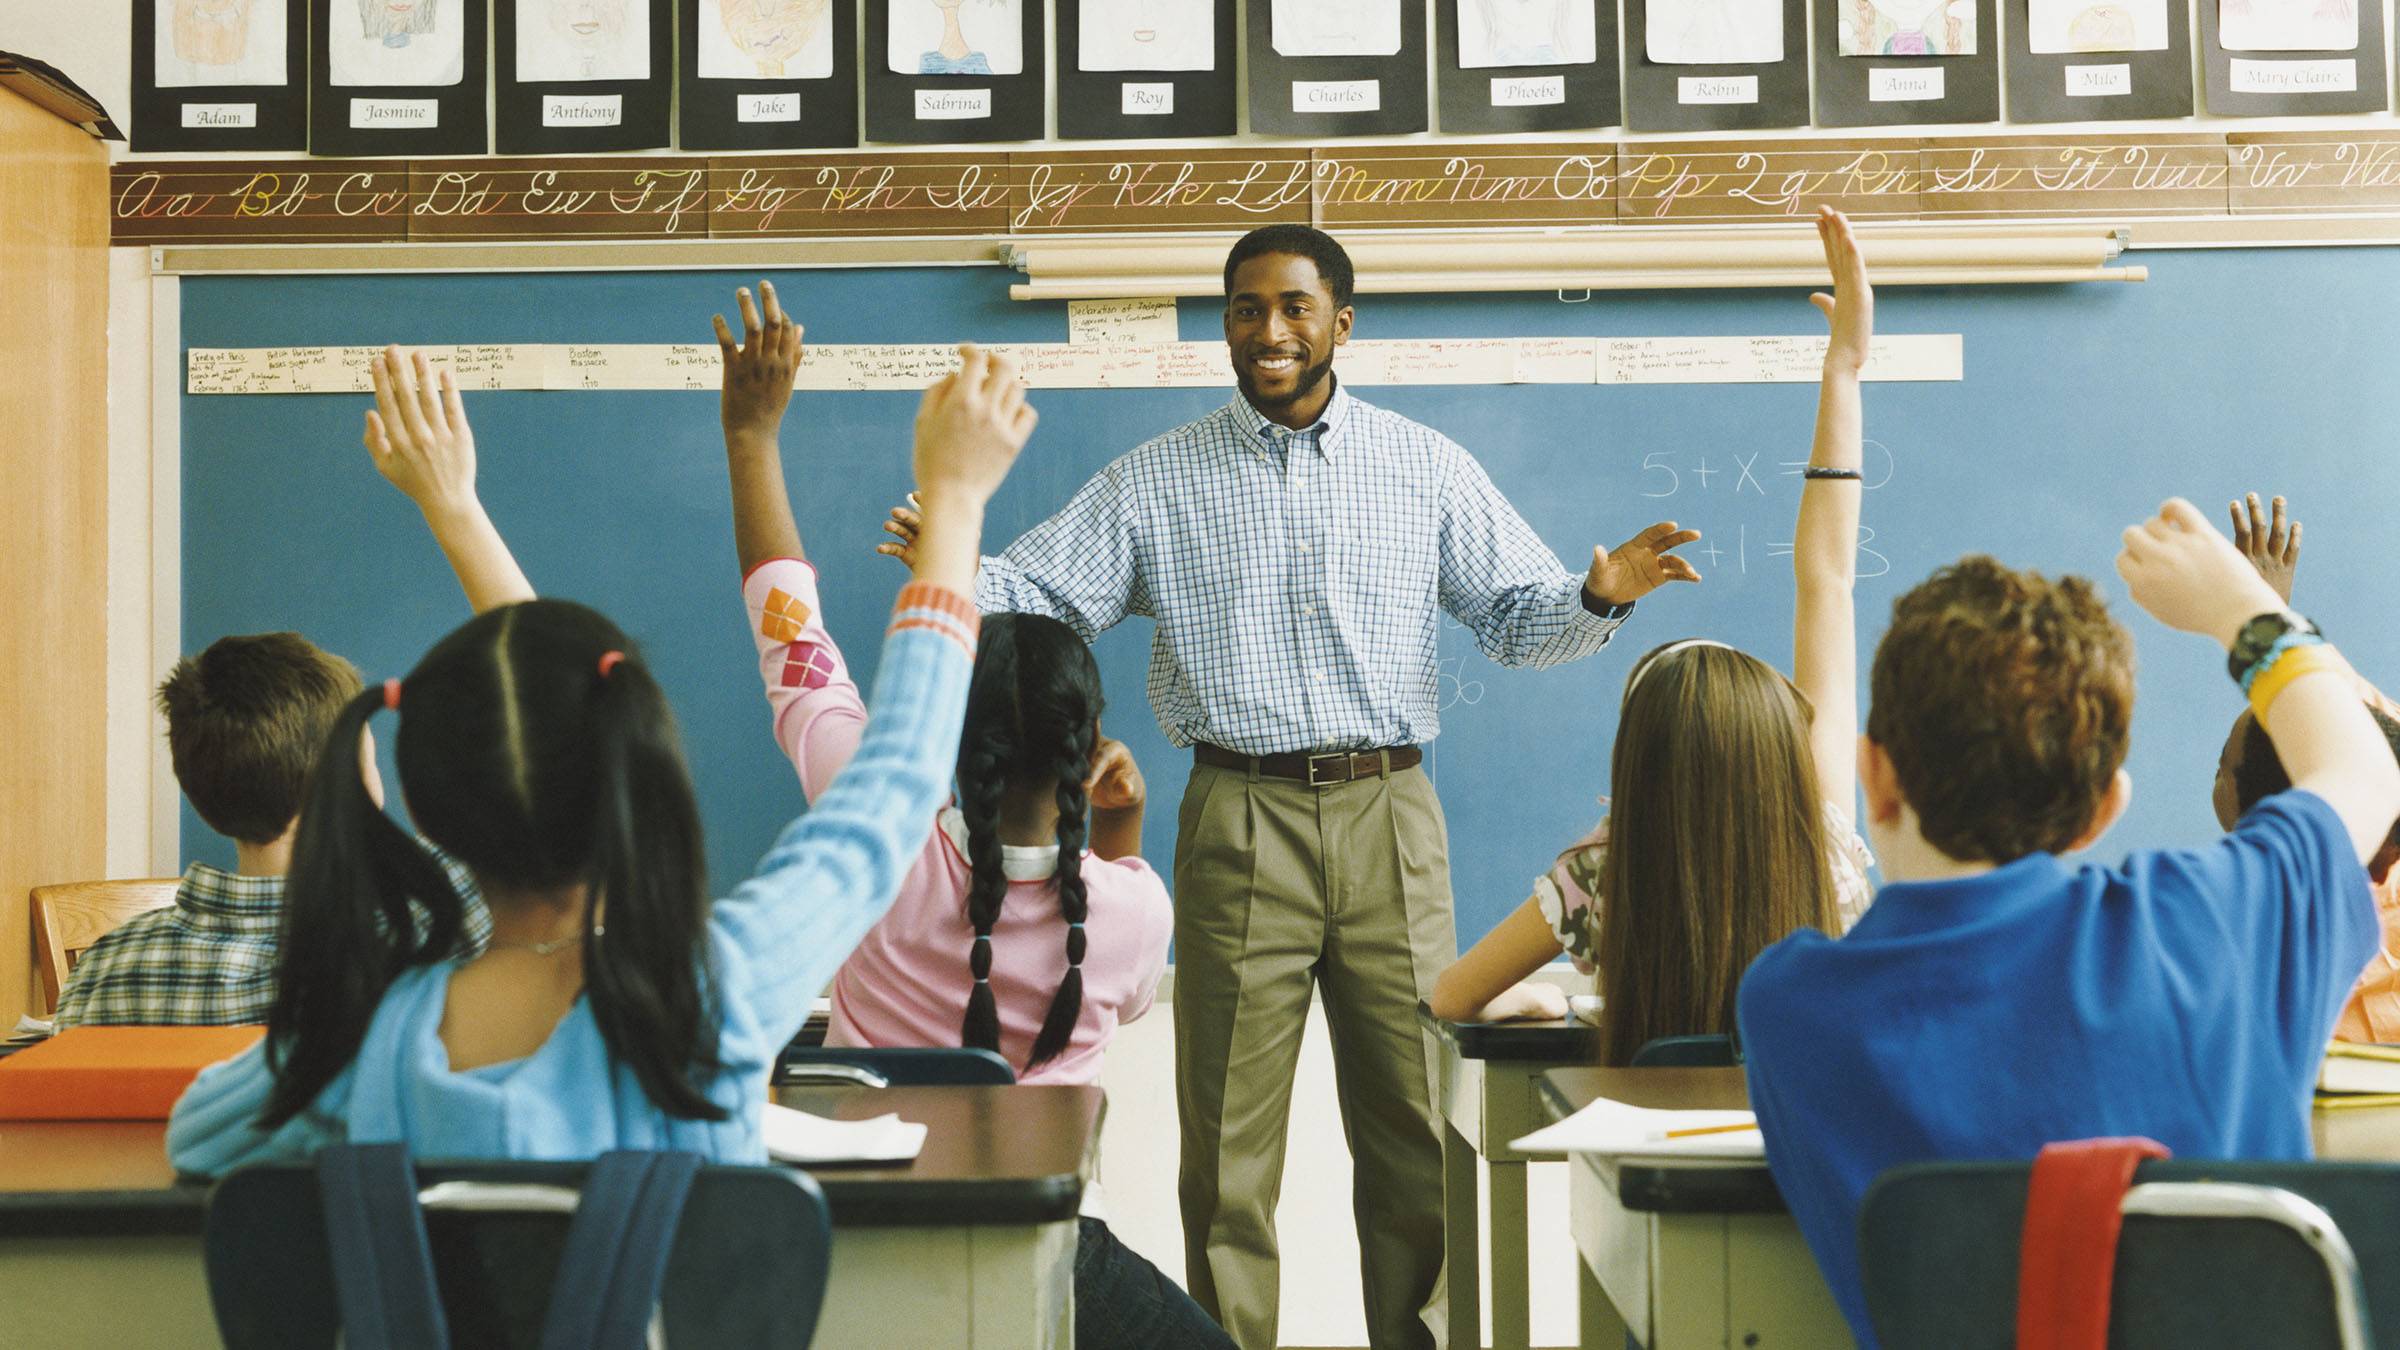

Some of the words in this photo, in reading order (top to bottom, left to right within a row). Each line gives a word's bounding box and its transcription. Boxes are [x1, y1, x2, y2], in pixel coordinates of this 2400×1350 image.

[1886, 76, 1927, 91] Anna
[2244, 69, 2289, 87] Mary
[2293, 67, 2342, 85] Claire
[1307, 87, 1364, 103] Charles
[1504, 83, 1557, 100] Phoebe
[1694, 81, 1741, 97] Robin
[922, 95, 982, 112] Sabrina
[1131, 90, 1164, 109] Roy
[364, 102, 426, 121] Jasmine
[550, 103, 617, 125] Anthony
[752, 98, 787, 117] Jake
[197, 109, 242, 126] Adam
[117, 170, 214, 219] Aa
[230, 171, 323, 219] Bb
[334, 171, 408, 217] Cc
[414, 170, 508, 217] Dd
[522, 170, 596, 215] Ee
[610, 169, 708, 234] Ff
[712, 168, 808, 231] Gg
[816, 166, 918, 213] Hh
[926, 165, 1012, 213] Ii
[1013, 164, 1101, 228] Jj
[1109, 162, 1216, 209] Kk
[1216, 161, 1313, 213] Ll
[1316, 157, 1442, 209] Mm
[1444, 156, 1546, 206] Nn
[1553, 155, 1622, 201] Oo
[1619, 152, 1720, 218] Pp
[1728, 152, 1830, 216] Qq
[1836, 147, 1922, 199] Rr
[1935, 147, 2024, 194] Ss
[2033, 145, 2120, 193] Tt
[2124, 144, 2229, 191] Uu
[2240, 143, 2326, 189] Vv
[1071, 303, 1117, 317] Declaration
[1121, 303, 1133, 313] of
[1083, 334, 1100, 345] July
[1118, 334, 1136, 343] 1776
[568, 347, 602, 359] Boston
[672, 346, 698, 355] Boston
[816, 347, 834, 357] Acts
[288, 360, 310, 370] Sugar
[665, 357, 681, 366] Tea
[686, 356, 709, 369] Party
[855, 361, 870, 370] The
[193, 385, 224, 393] February
[294, 383, 312, 392] 1764
